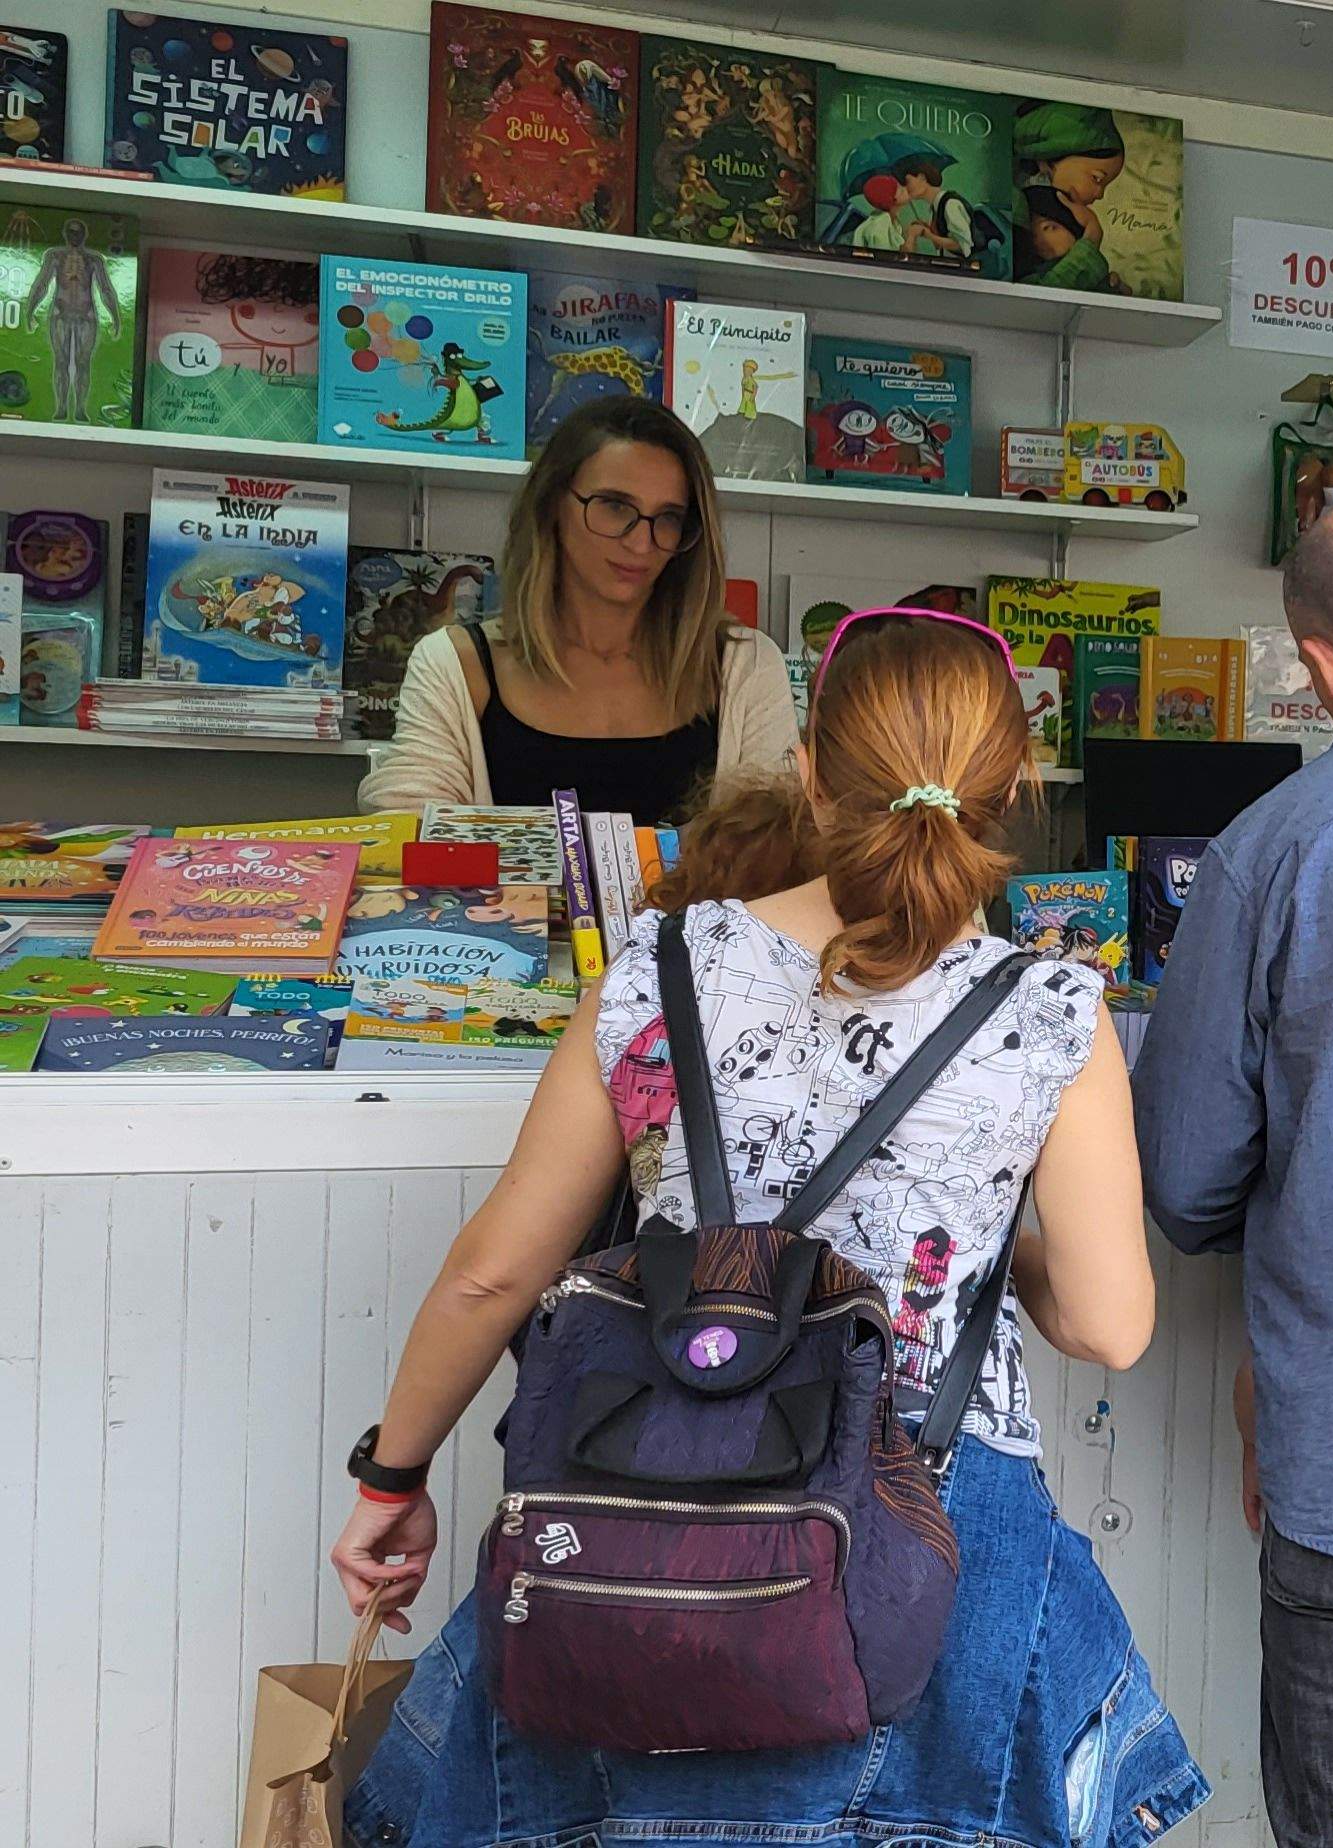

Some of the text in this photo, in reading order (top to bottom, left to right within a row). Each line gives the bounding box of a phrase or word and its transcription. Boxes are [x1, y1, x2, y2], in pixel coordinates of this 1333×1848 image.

[211, 58, 244, 81] EL
[128, 71, 323, 125] SISTEMA
[842, 93, 866, 122] TE
[877, 101, 992, 138] QUIERO
[159, 112, 290, 159] SOLAR
[506, 116, 570, 145] BRUJAS
[711, 153, 766, 178] HADAS
[336, 267, 512, 294] EL EMOCIONÓMETRO
[336, 281, 512, 306] DEL INSPECTOR DRILO
[552, 291, 659, 319] JIRAFAS
[687, 317, 793, 344] El Principito
[1252, 314, 1293, 327] TAMBIÉN
[1296, 320, 1322, 331] PAGO
[550, 325, 621, 345] BAILAR
[168, 341, 210, 367] tú
[841, 356, 923, 380] te quiero
[1092, 464, 1153, 478] AUTOBÚS
[225, 477, 296, 500] Astérix
[216, 497, 282, 521] Astérix
[179, 519, 212, 542] EN
[222, 523, 248, 539] LA
[998, 601, 1154, 635] Dinosaurios
[1003, 628, 1044, 645] De la
[202, 821, 392, 841] Hermanos
[559, 799, 580, 847] ARTA
[183, 860, 288, 880] CUENTOS
[283, 873, 310, 885] DE
[1107, 907, 1115, 917] 2
[146, 939, 235, 948] cambiando
[251, 940, 308, 949] mundo
[240, 932, 267, 942] que
[270, 929, 321, 941] están
[355, 941, 506, 963] HABITACIÓN
[382, 958, 491, 978] RUIDOSA
[256, 990, 310, 1000] TODO
[375, 990, 426, 1001] TODO
[62, 1028, 315, 1048] ¡BUENAS NOCHES, PERRITO!
